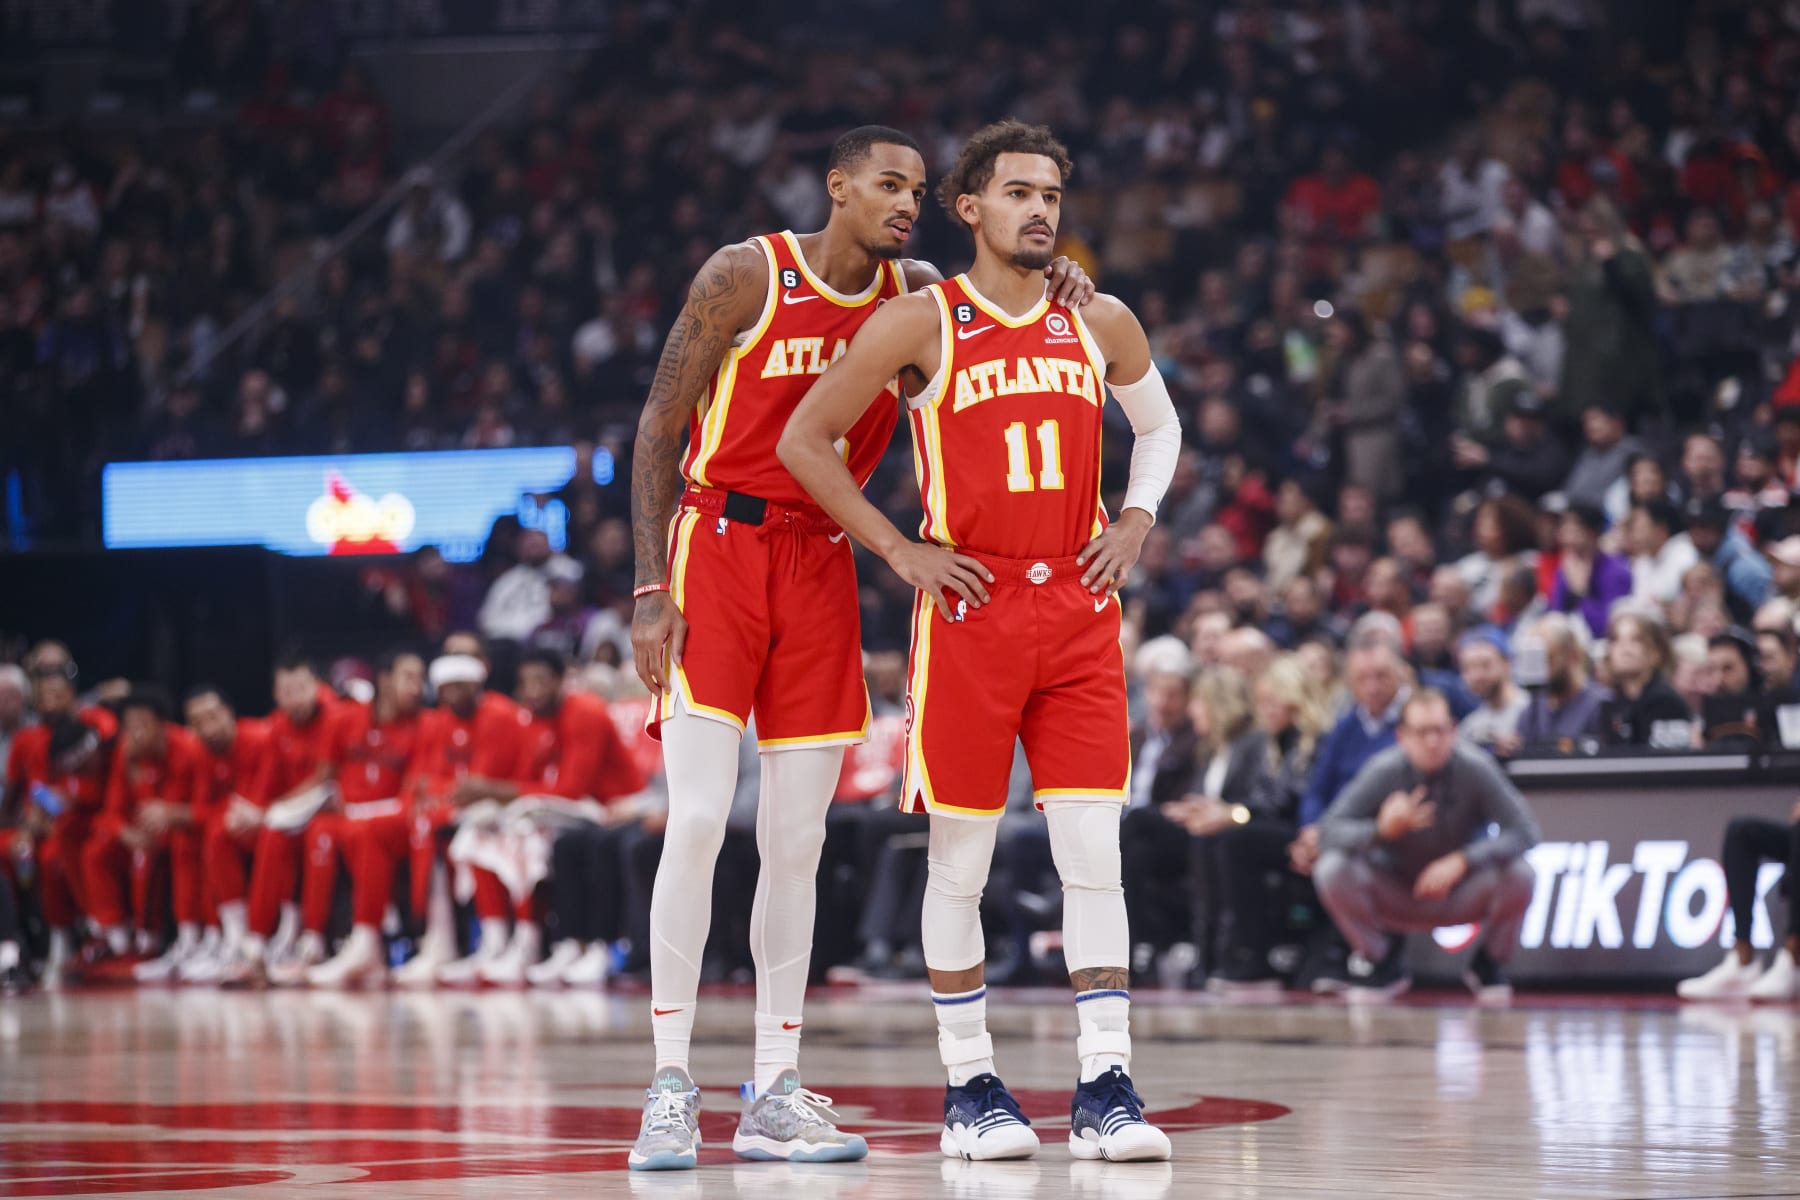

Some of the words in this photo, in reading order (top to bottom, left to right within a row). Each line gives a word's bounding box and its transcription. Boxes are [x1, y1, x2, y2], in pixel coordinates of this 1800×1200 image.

[783, 270, 797, 287] 6
[957, 305, 970, 322] 6
[953, 356, 1099, 414] ATLANTA
[1004, 419, 1065, 492] 11
[1026, 568, 1052, 578] HAWKS
